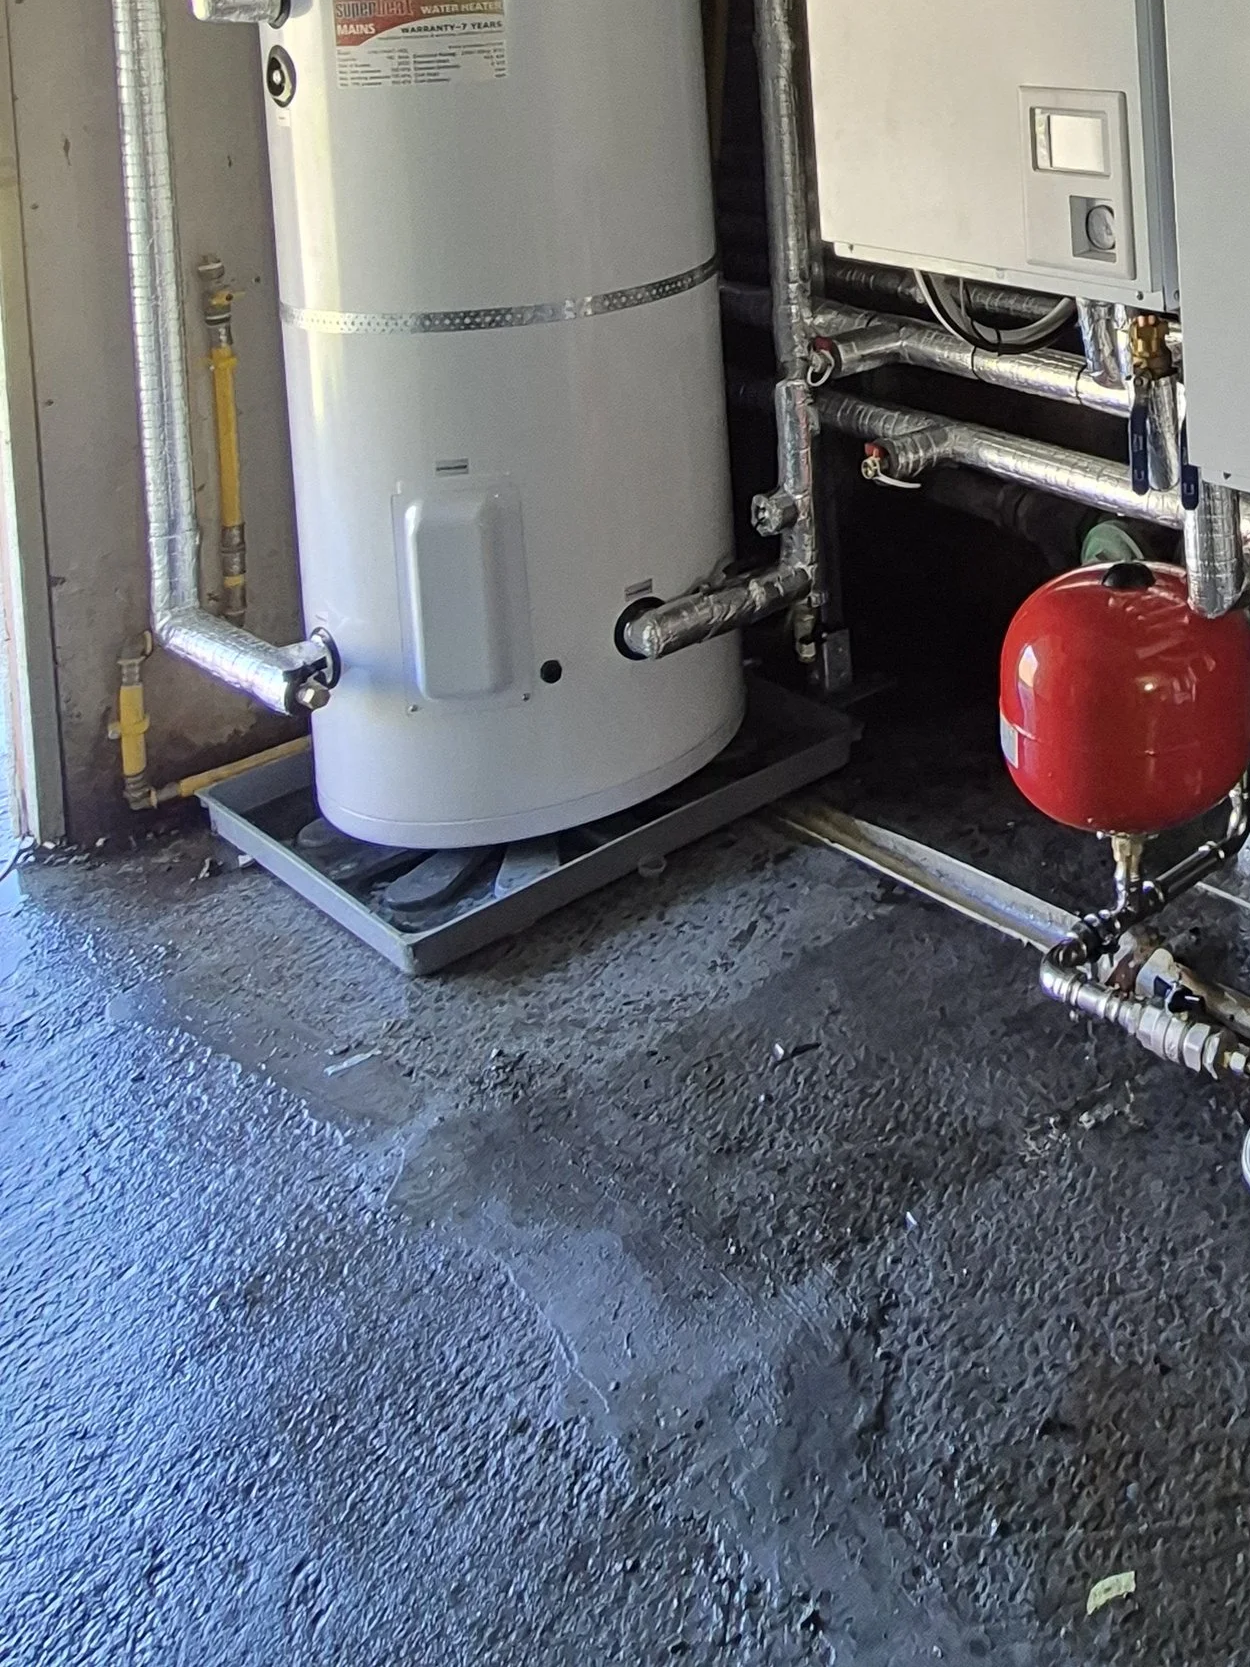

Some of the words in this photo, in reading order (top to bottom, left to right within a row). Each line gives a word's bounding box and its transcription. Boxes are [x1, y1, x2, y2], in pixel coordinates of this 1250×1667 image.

[420, 3, 459, 15] WATER
[336, 23, 376, 36] MAINS
[471, 20, 503, 31] YEARS
